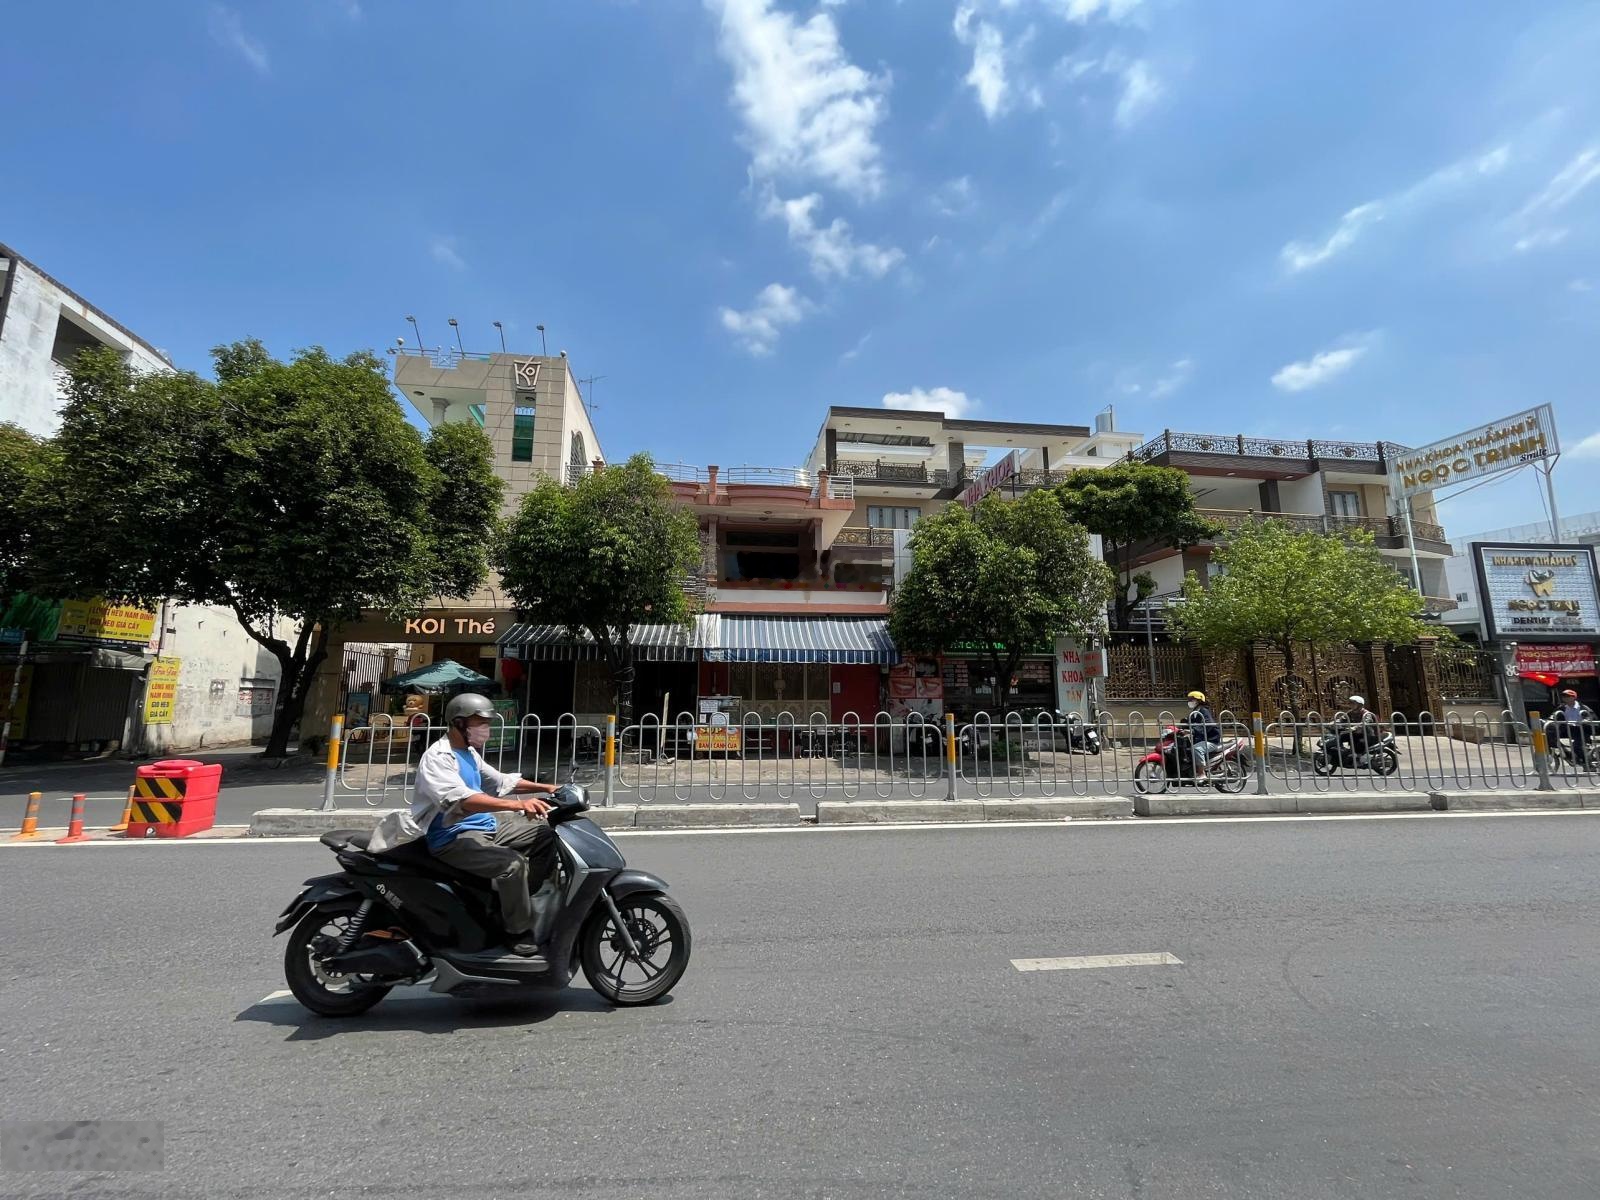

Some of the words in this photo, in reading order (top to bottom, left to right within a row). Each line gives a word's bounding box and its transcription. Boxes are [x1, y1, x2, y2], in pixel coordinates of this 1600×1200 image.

[1396, 458, 1421, 473] NHA
[1425, 444, 1462, 464] KHOA
[1520, 448, 1547, 461] Smile
[1404, 458, 1471, 488] NGỌC
[405, 618, 445, 635] KOI
[454, 617, 495, 635] Thé
[1512, 616, 1551, 625] DENTIST
[1063, 650, 1080, 663] NHA
[1062, 670, 1084, 683] KHOA
